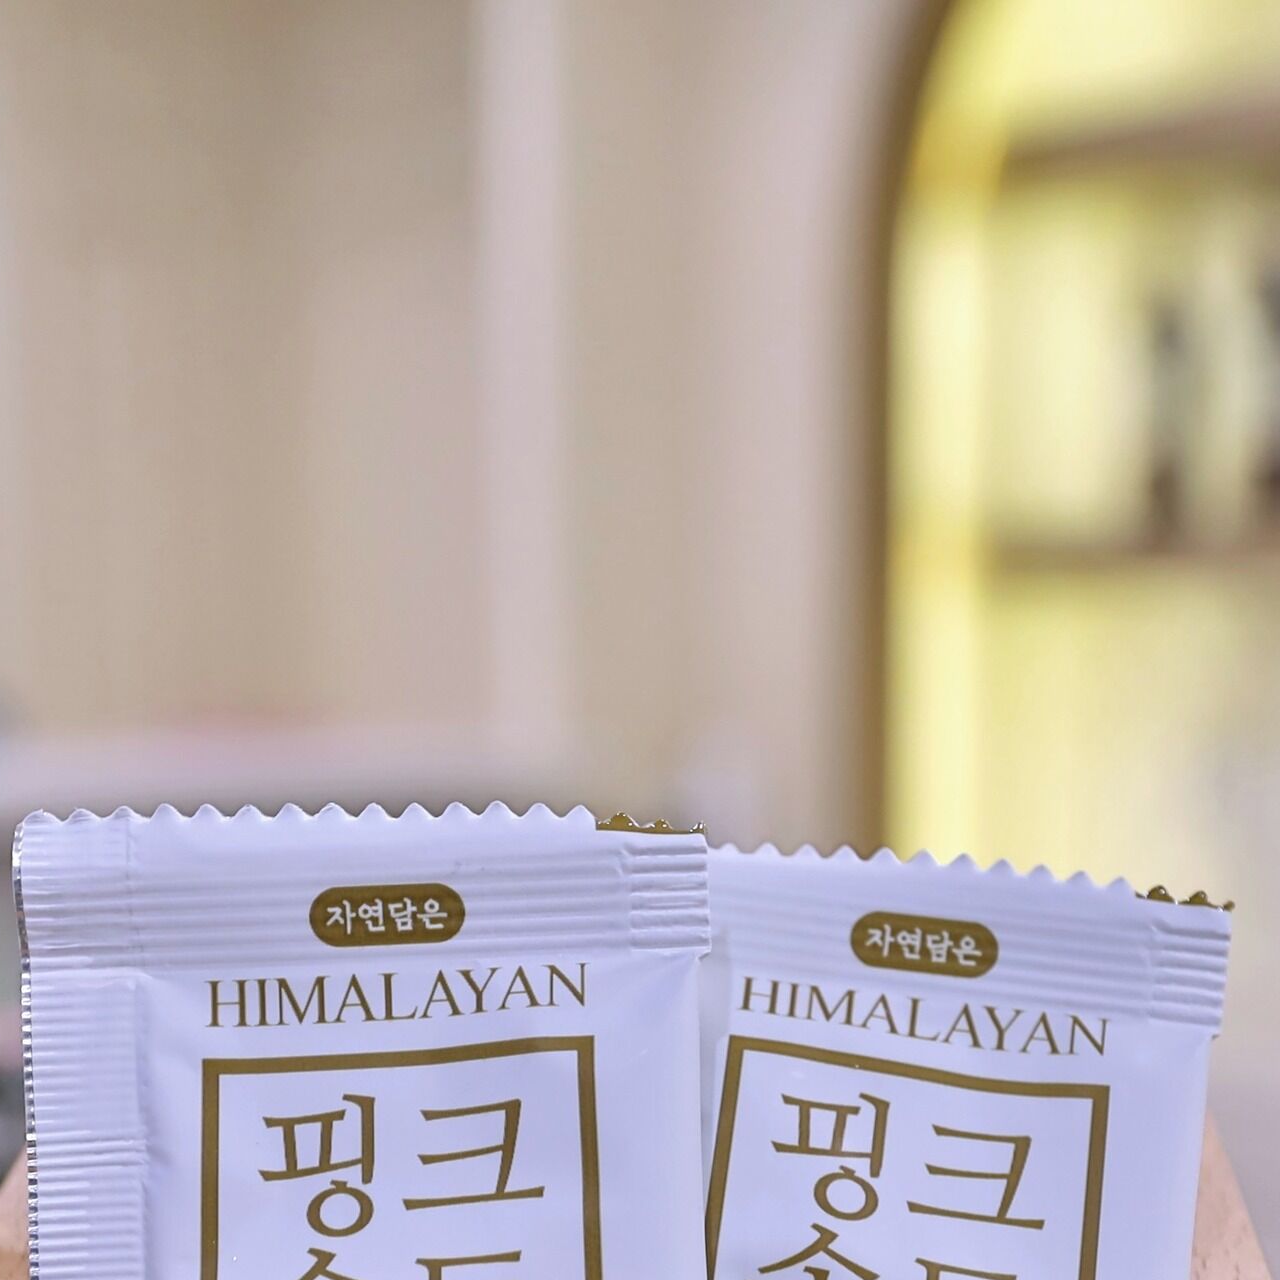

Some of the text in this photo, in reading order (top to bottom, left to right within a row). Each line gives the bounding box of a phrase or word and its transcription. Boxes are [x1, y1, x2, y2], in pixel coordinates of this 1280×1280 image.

[325, 897, 449, 935] 자연담은
[864, 923, 983, 967] 자연담은
[204, 961, 590, 1028] HIMALAYAN
[736, 975, 1112, 1057] HIMALAYAN
[257, 1093, 545, 1237] 핑크
[770, 1092, 1046, 1231] 핑크
